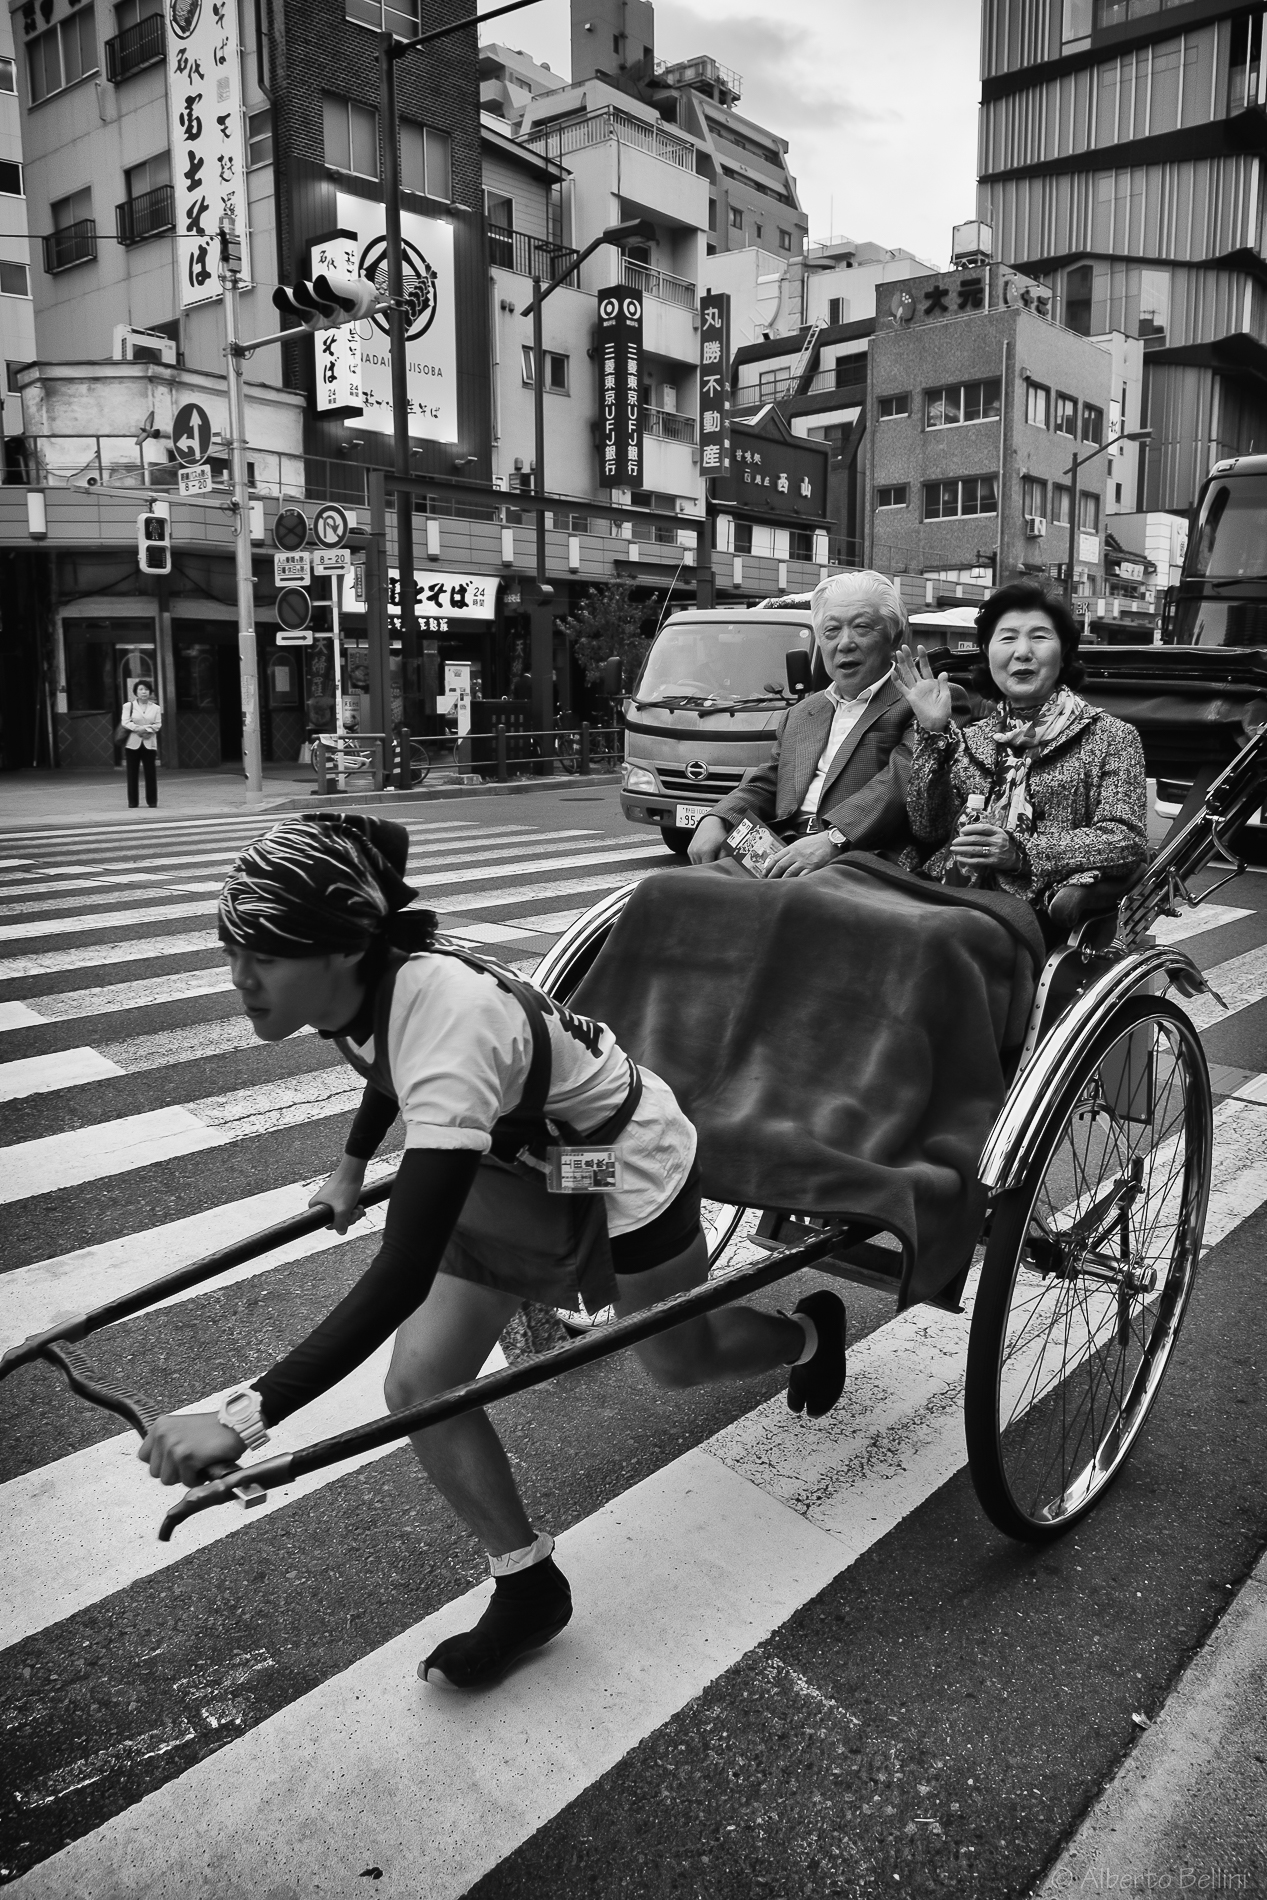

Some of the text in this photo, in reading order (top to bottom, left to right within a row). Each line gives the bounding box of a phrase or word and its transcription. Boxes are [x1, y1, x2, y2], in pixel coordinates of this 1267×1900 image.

[924, 277, 984, 315] 大元
[328, 389, 336, 397] 24
[350, 383, 359, 391] 24
[703, 306, 721, 468] 丸勝不動産
[604, 343, 616, 475] 三菱東京UFJ銀行
[627, 343, 638, 475] 三菱東京UFJ銀行
[778, 473, 812, 498] 西山
[474, 587, 485, 597] 24
